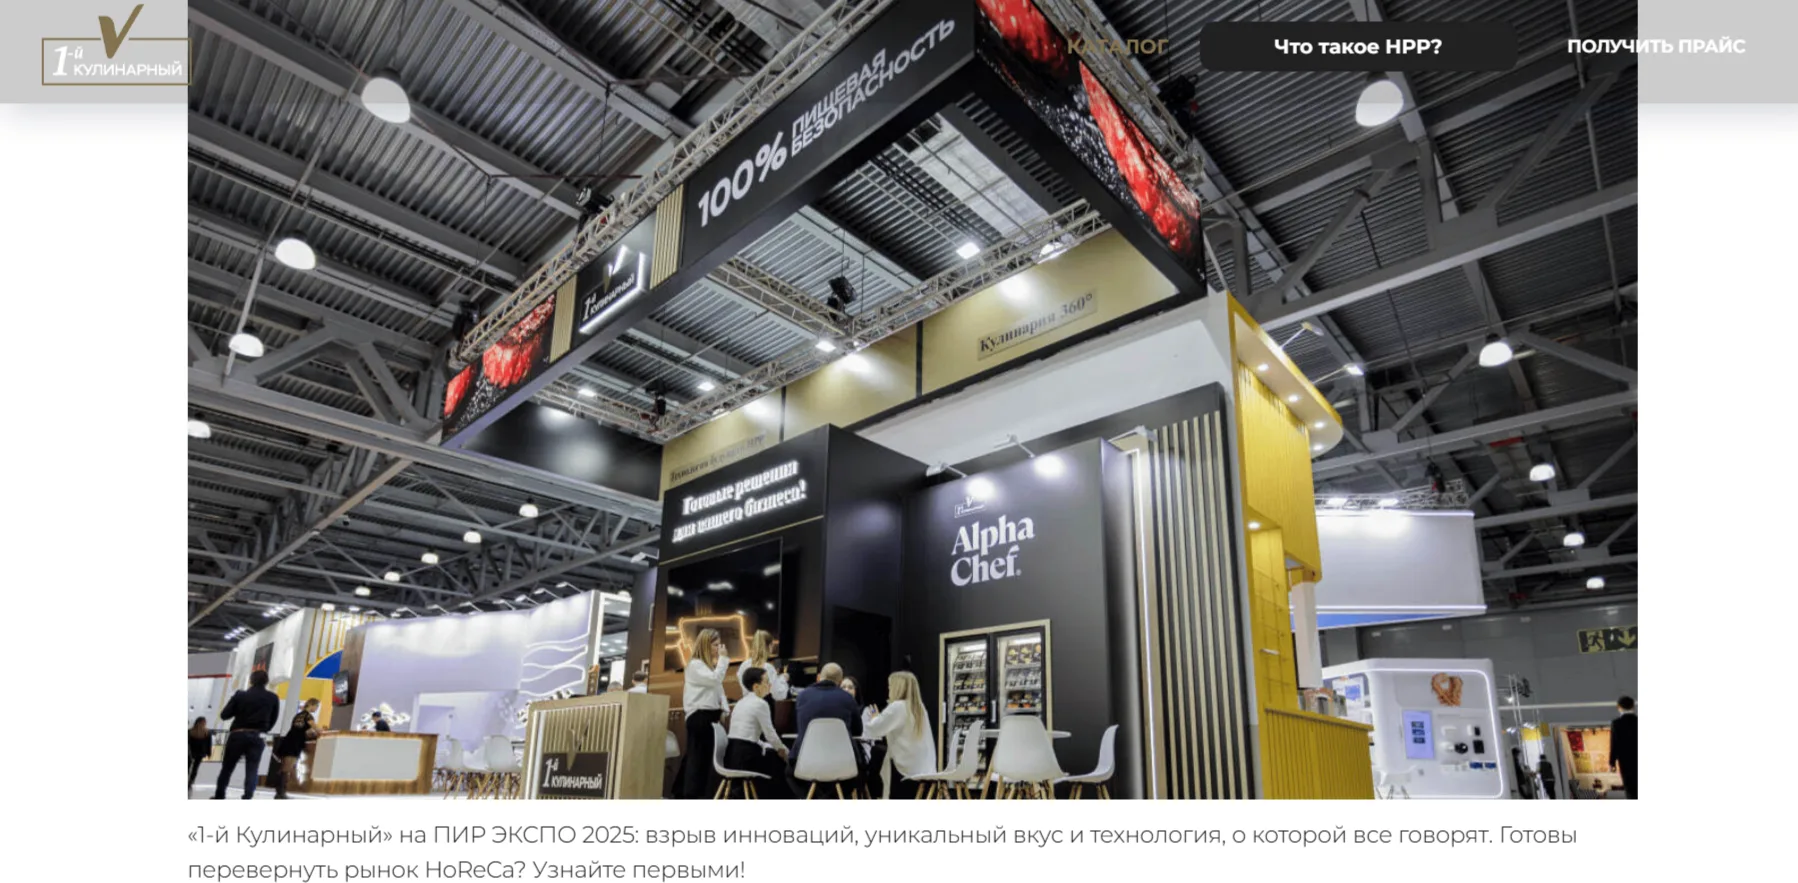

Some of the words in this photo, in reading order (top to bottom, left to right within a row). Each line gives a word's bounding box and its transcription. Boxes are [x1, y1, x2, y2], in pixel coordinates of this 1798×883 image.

[698, 131, 787, 227] 100%
[791, 18, 956, 157] БЕЗОПАСНОСТЬ
[792, 48, 886, 139] ПИЩЕВАЯ
[980, 312, 1056, 352] Кулинария
[1061, 292, 1093, 318] 360°
[682, 486, 734, 516] Готовые
[734, 459, 799, 500] решения
[951, 514, 1036, 556] Alpha
[551, 773, 603, 790] КУЛИНАРНЫЙ
